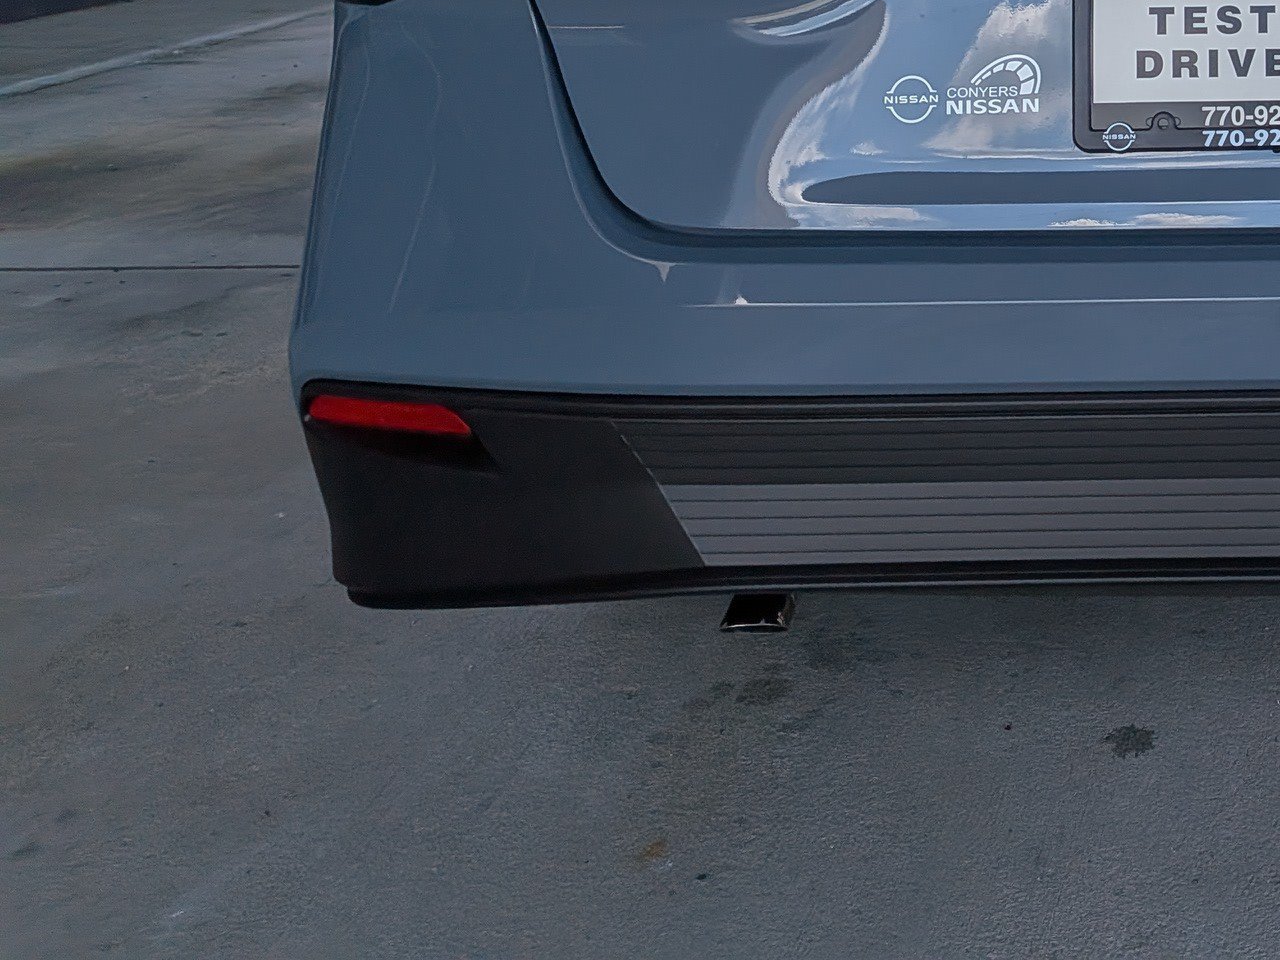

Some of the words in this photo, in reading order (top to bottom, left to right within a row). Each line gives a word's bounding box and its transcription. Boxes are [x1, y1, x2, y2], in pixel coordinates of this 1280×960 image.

[1149, 5, 1276, 35] TEST
[947, 86, 1018, 98] CONYERS
[884, 94, 939, 104] NISSAN
[946, 98, 1039, 115] NISSAN
[1102, 133, 1136, 141] NISSAN
